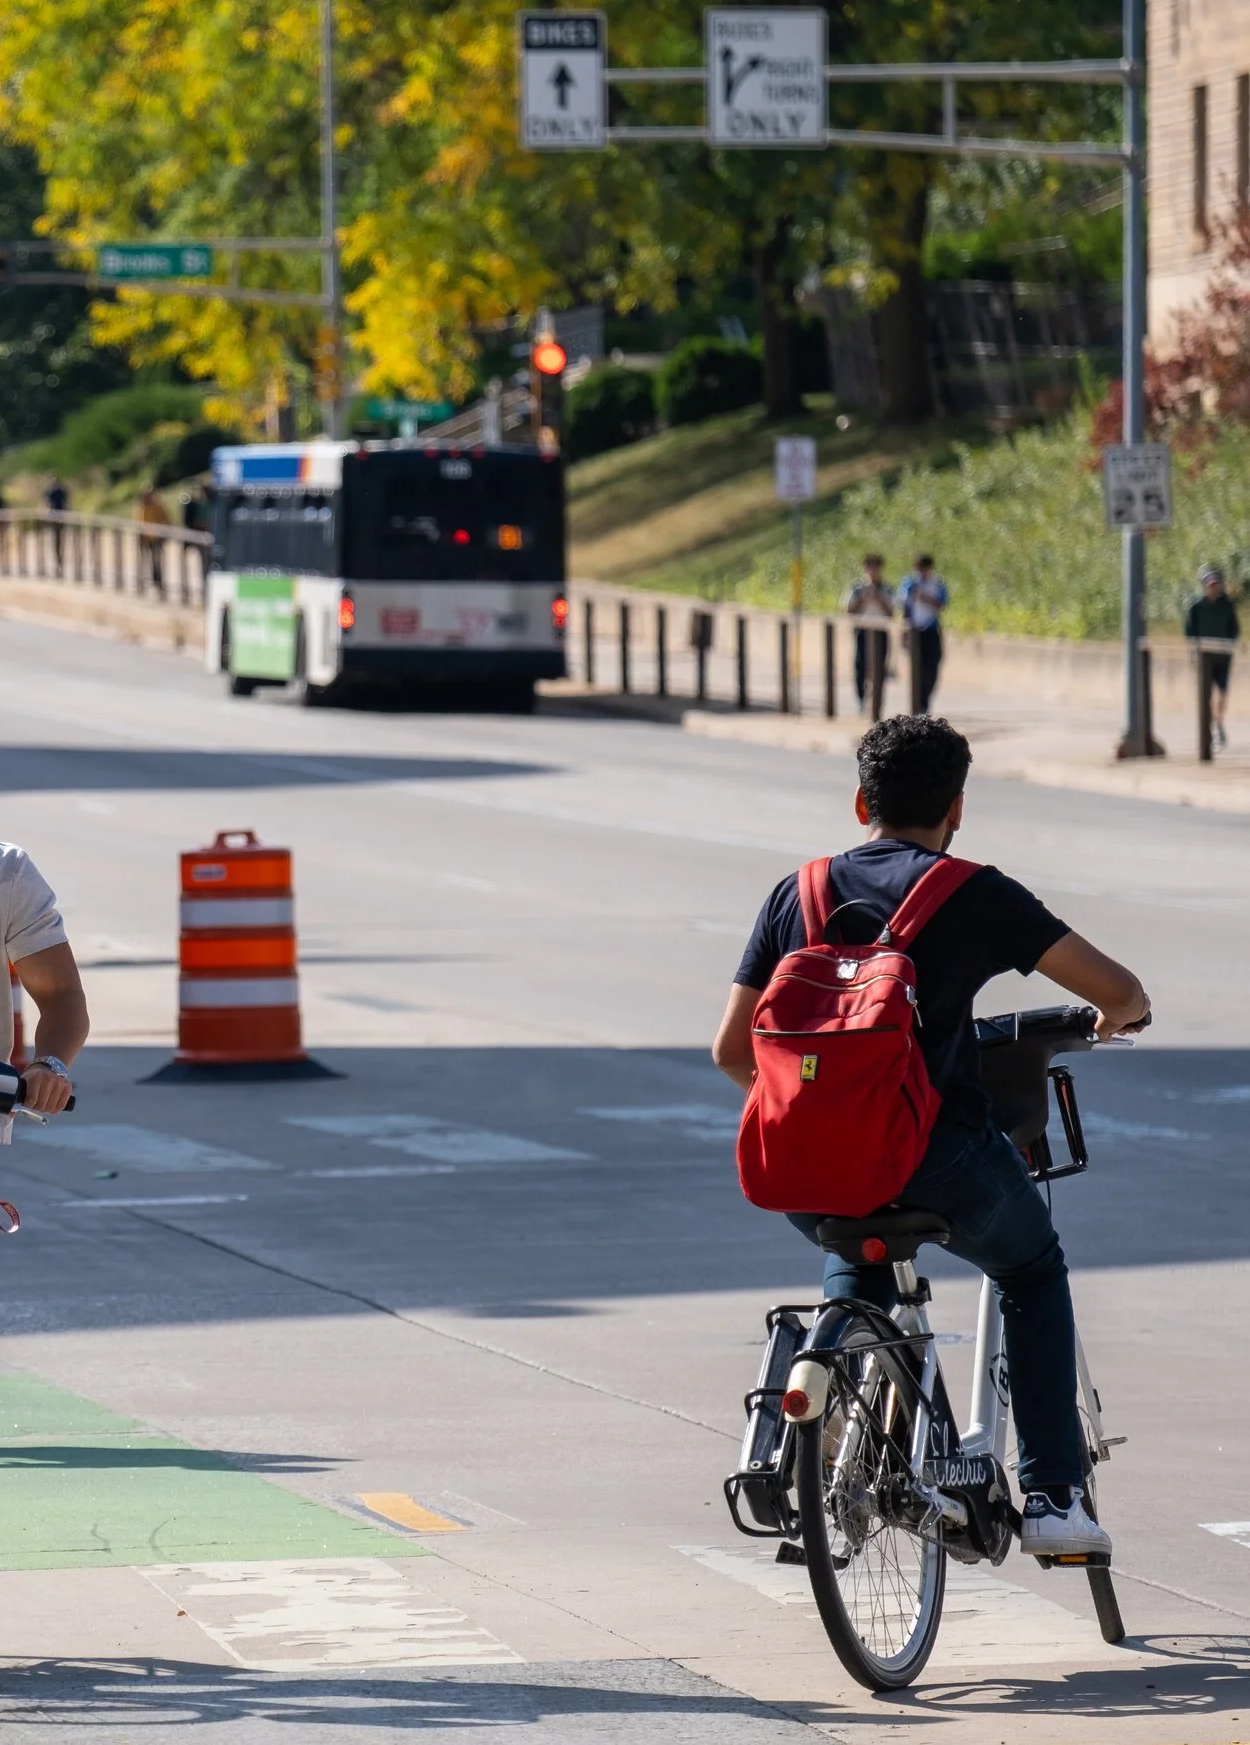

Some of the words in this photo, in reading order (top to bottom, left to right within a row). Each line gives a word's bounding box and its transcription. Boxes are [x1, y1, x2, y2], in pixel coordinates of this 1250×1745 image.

[528, 20, 597, 47] BIKES
[528, 116, 599, 141] ONLY
[726, 111, 807, 139] ONLY
[1113, 488, 1165, 524] 25
[930, 1420, 987, 1487] Electric
